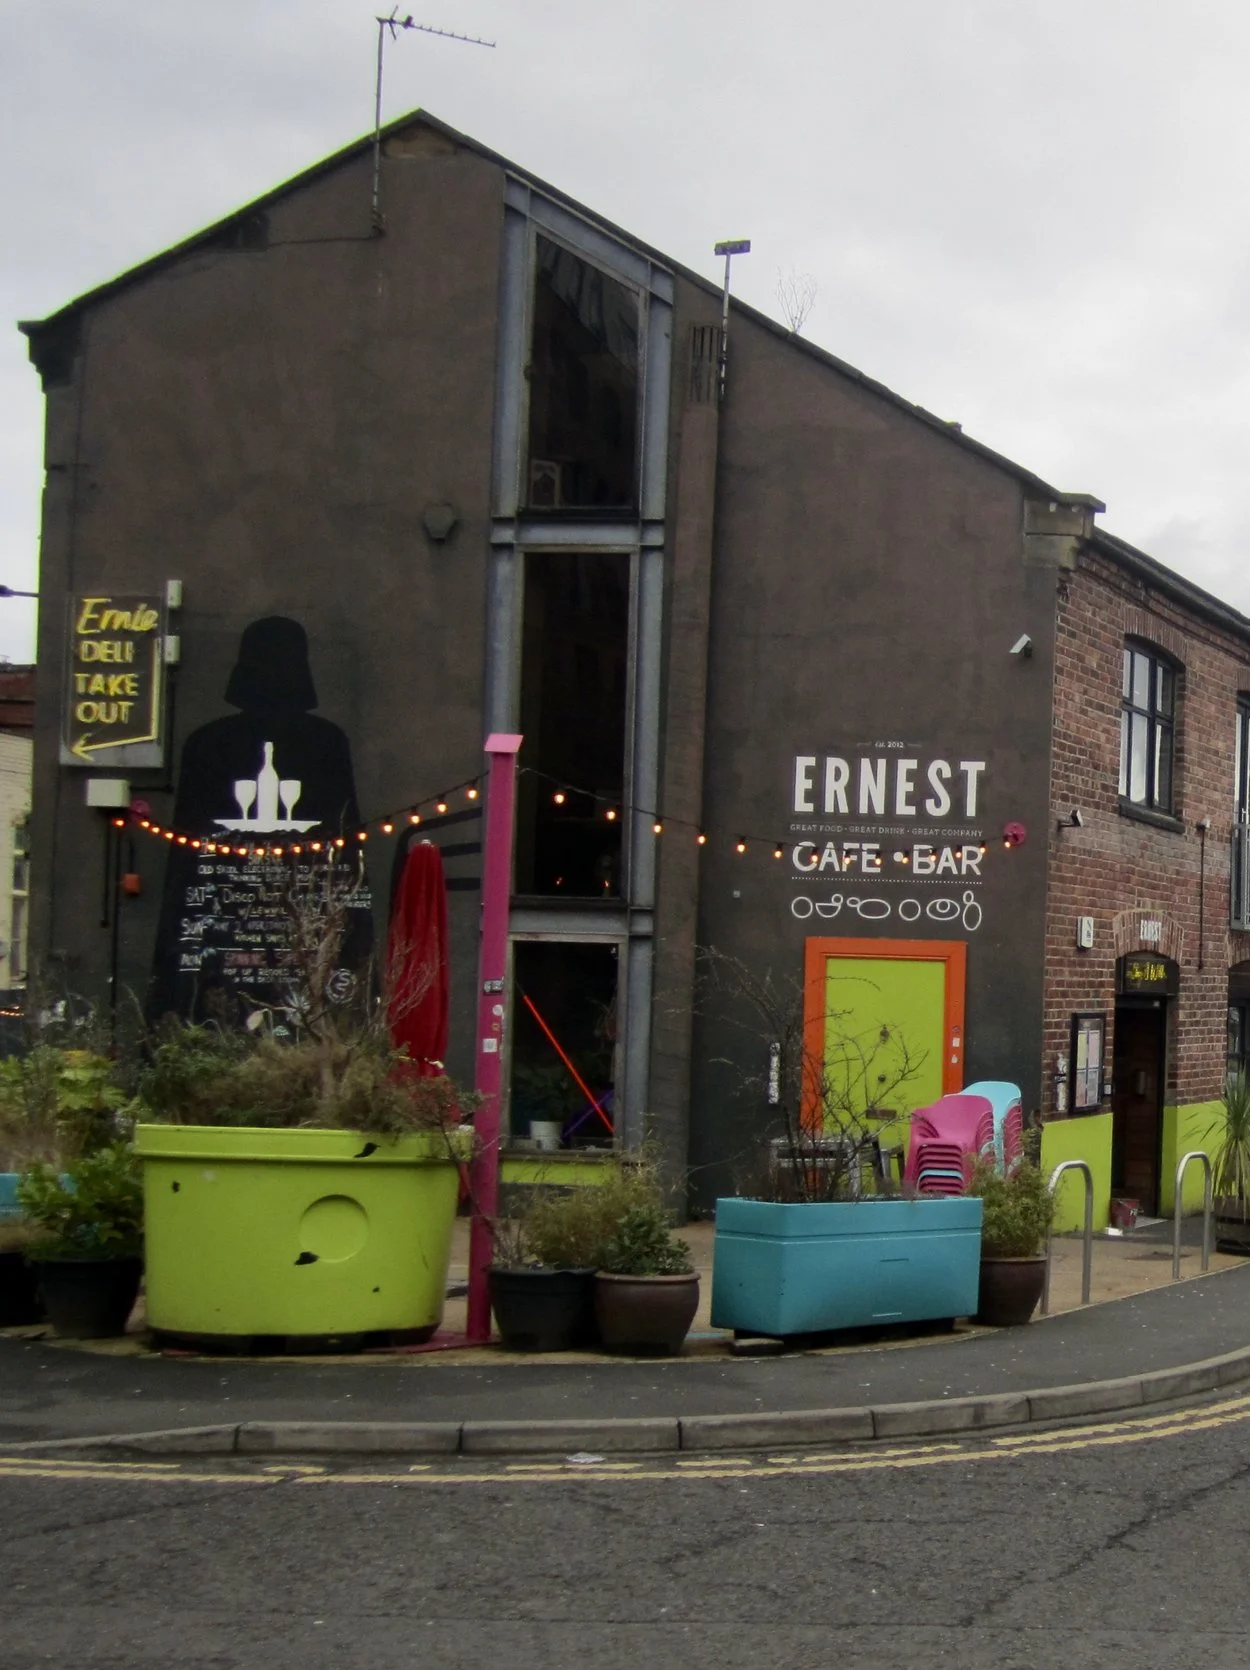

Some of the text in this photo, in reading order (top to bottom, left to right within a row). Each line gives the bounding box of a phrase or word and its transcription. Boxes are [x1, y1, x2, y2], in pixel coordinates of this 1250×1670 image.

[76, 598, 158, 634] Ernie
[80, 640, 134, 663] DELI
[74, 673, 139, 696] TAKE
[76, 701, 135, 724] OUT
[794, 756, 986, 817] ERNEST
[790, 824, 983, 838] GREAT FOOD GREAT DRINK GREAT COMPANY
[792, 841, 983, 875] CAFE BAR
